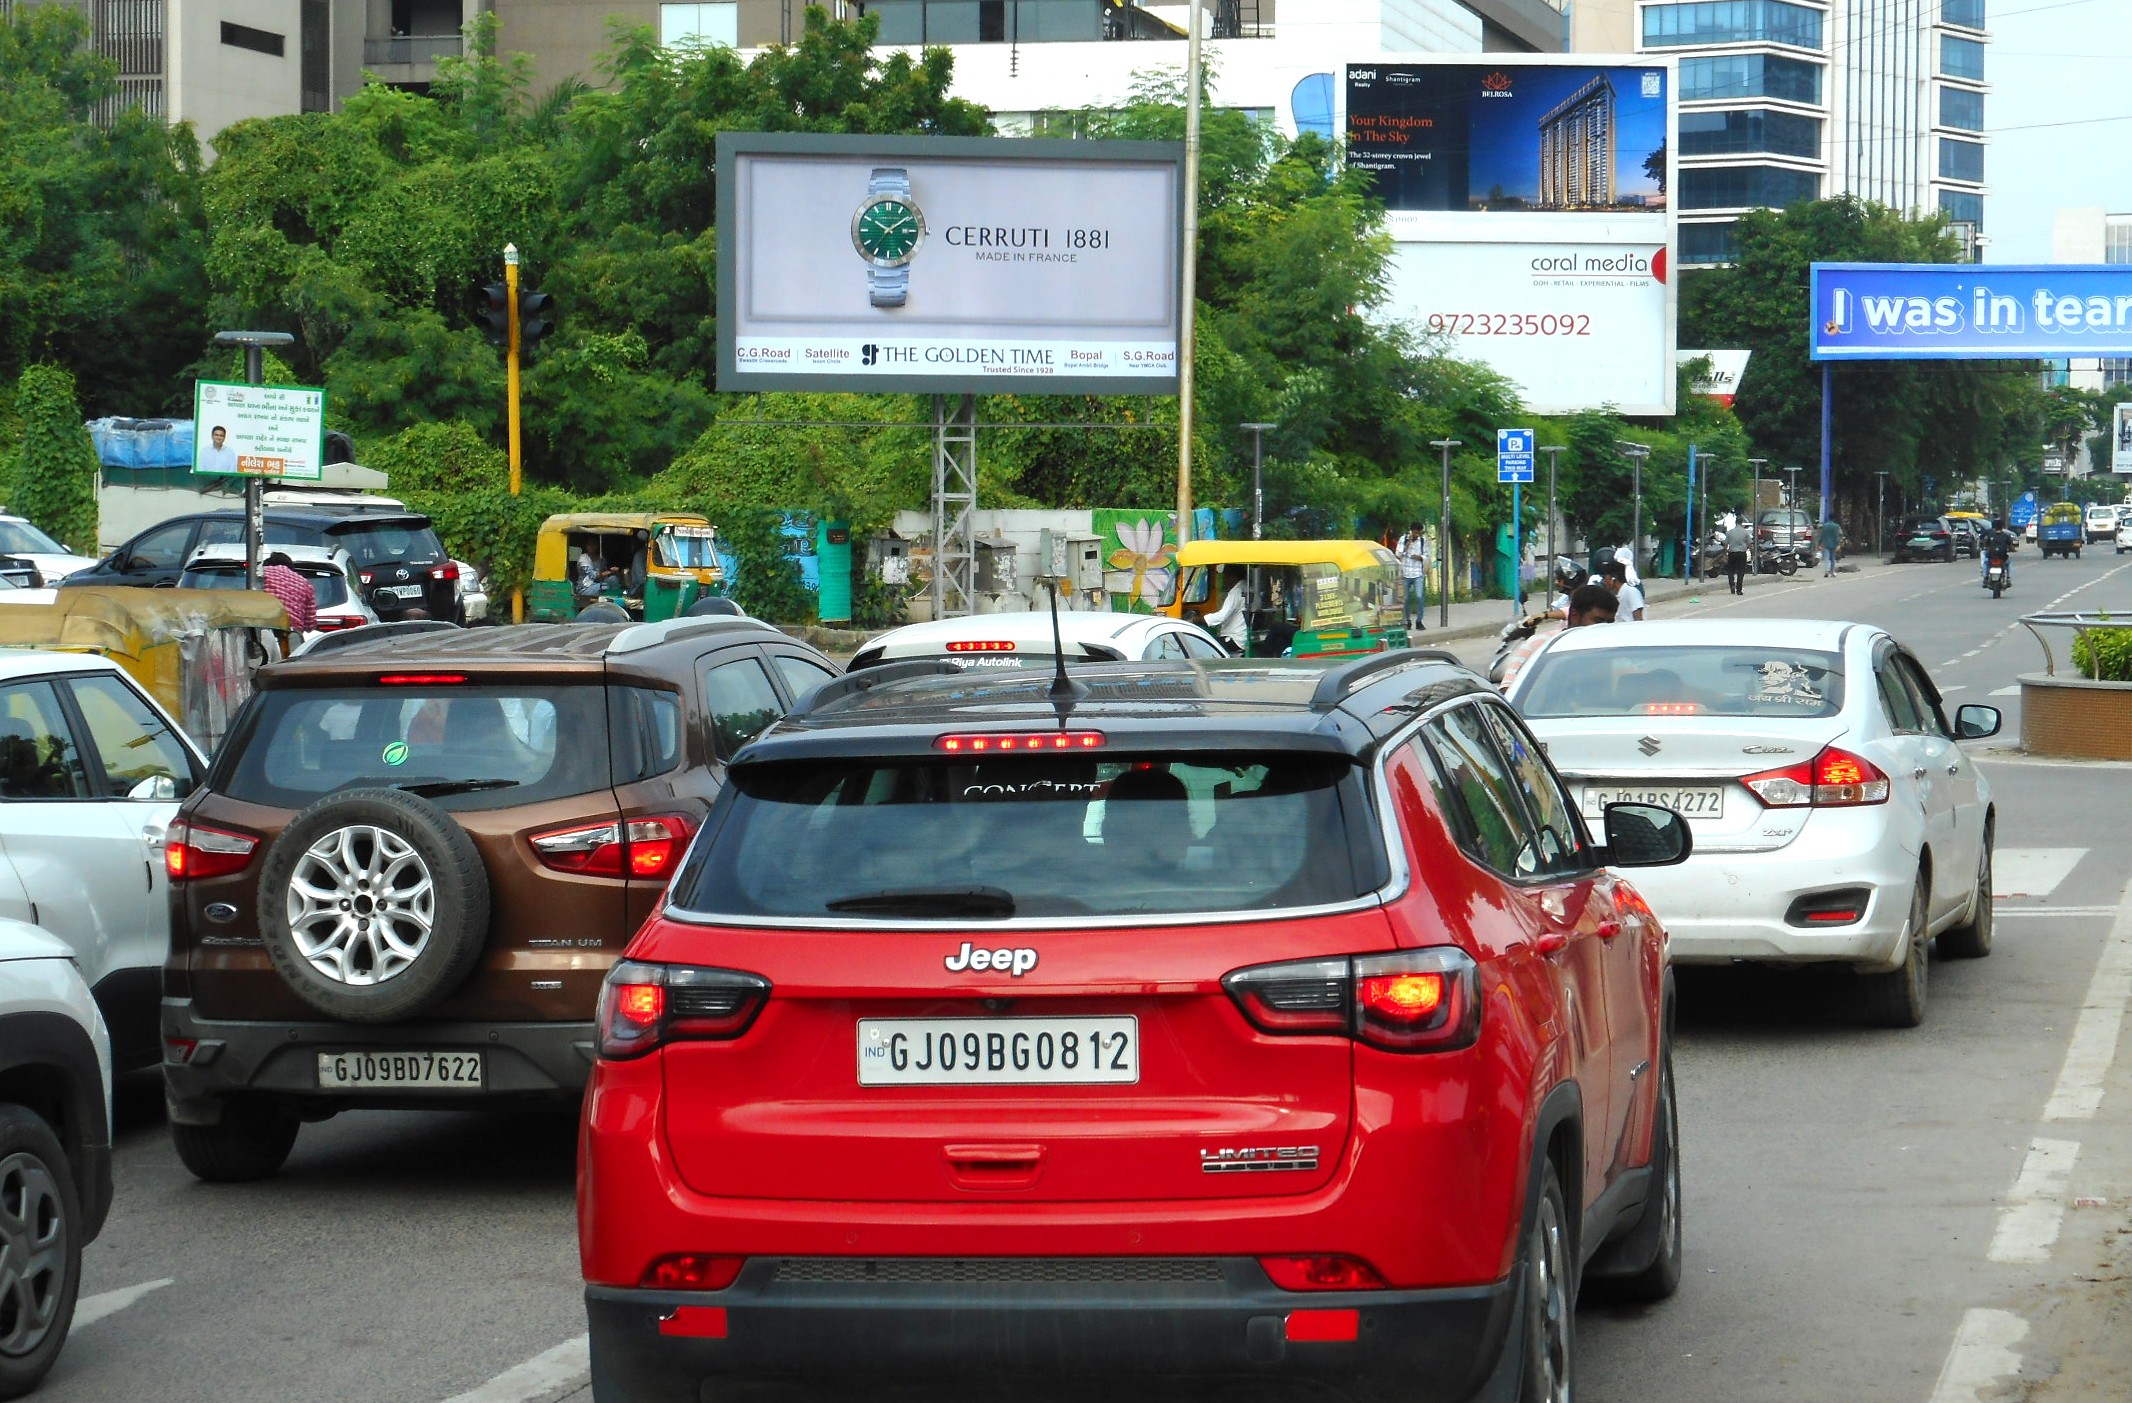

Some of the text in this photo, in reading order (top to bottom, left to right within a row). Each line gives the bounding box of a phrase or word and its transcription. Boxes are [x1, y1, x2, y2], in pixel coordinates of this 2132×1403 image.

[1349, 69, 1376, 80] adani
[1350, 116, 1433, 129] Your Kingdom
[1364, 130, 1388, 142] The
[1389, 132, 1410, 144] Sky
[1357, 162, 1396, 170] Shantigram.
[945, 226, 1109, 248] CERRUTI 1881
[976, 252, 1078, 263] MADE IN FRANCE
[1532, 254, 1648, 272] coral media
[1834, 289, 1847, 328] I
[1863, 297, 1959, 329] was
[1975, 288, 2020, 329] in
[1428, 314, 1591, 335] 9723235092
[737, 347, 791, 358] C.G.Road
[805, 348, 850, 358] Satellite
[883, 346, 1054, 364] THE GOLDEN TIME
[1070, 350, 1102, 361] Bopal
[1123, 351, 1174, 360] S.G.Road
[952, 657, 1022, 668] Riya Autolink
[1774, 694, 1792, 703] श्री
[944, 942, 1039, 977] Jeep
[865, 1031, 1128, 1071] IND GJ09BG0812
[335, 1057, 479, 1081] GJ09BD7622
[1200, 1146, 1320, 1159] LIMITED
